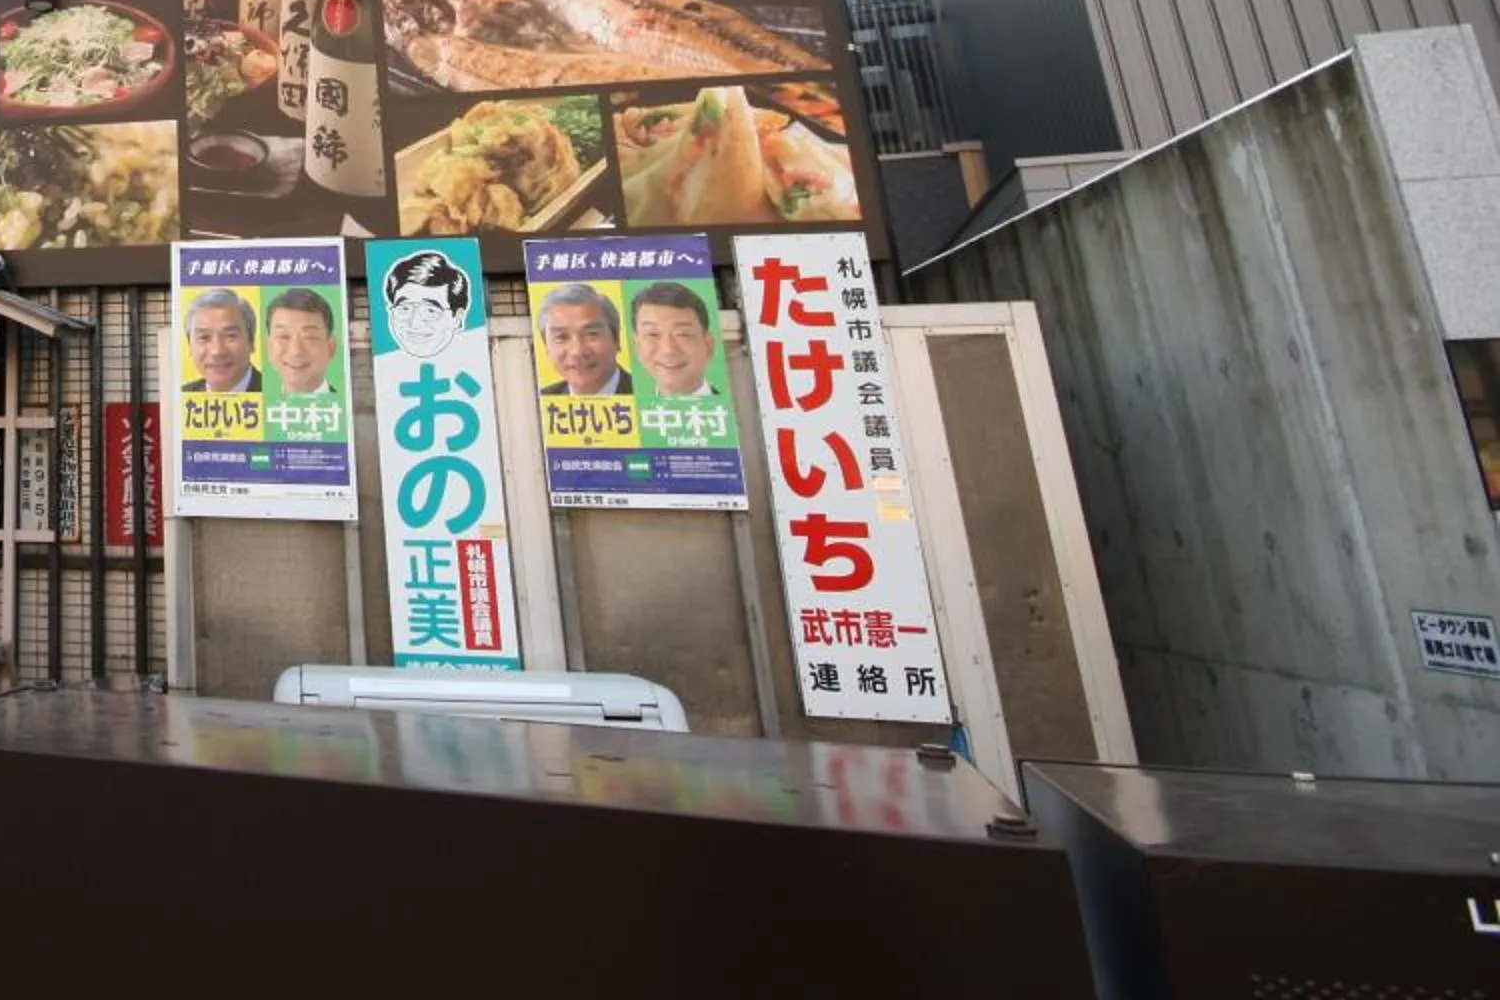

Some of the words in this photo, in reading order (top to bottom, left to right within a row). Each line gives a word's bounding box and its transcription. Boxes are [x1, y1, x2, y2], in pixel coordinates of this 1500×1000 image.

[837, 255, 898, 473] 札幌市議会議員
[184, 398, 260, 431] たけいち
[266, 400, 343, 433] 中村
[547, 401, 633, 436] たけいち
[640, 403, 729, 438] 中村
[752, 257, 875, 594] たけいち
[799, 608, 928, 649] 武市憲一
[808, 661, 938, 697] 連絡所
